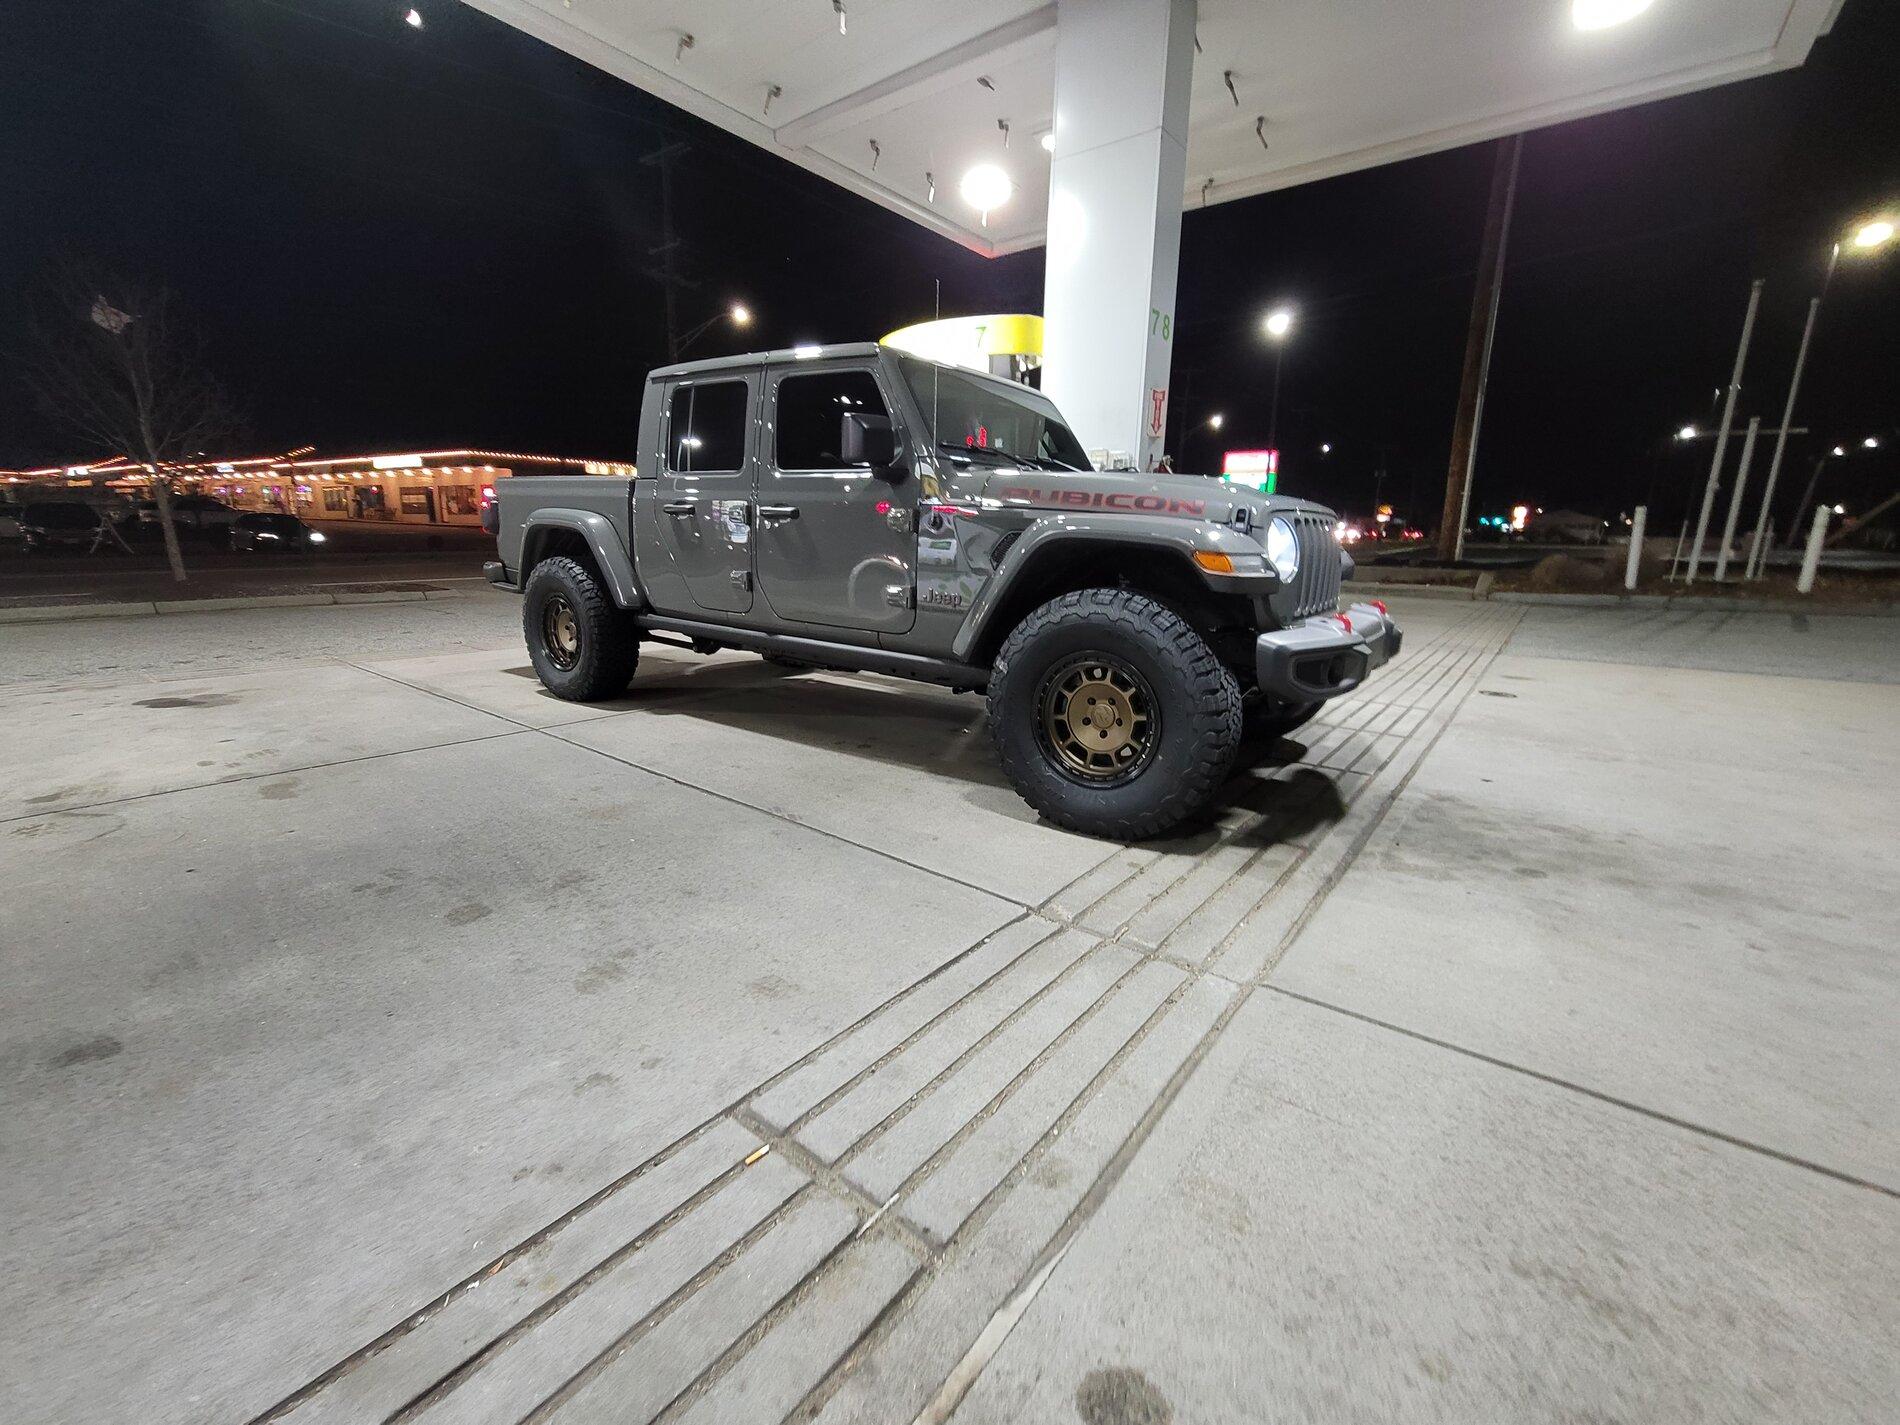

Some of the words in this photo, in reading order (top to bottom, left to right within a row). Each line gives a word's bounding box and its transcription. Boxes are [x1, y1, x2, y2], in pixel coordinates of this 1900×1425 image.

[975, 325, 987, 349] 7
[1001, 486, 1205, 515] RUBICON
[922, 587, 962, 607] Jeep
